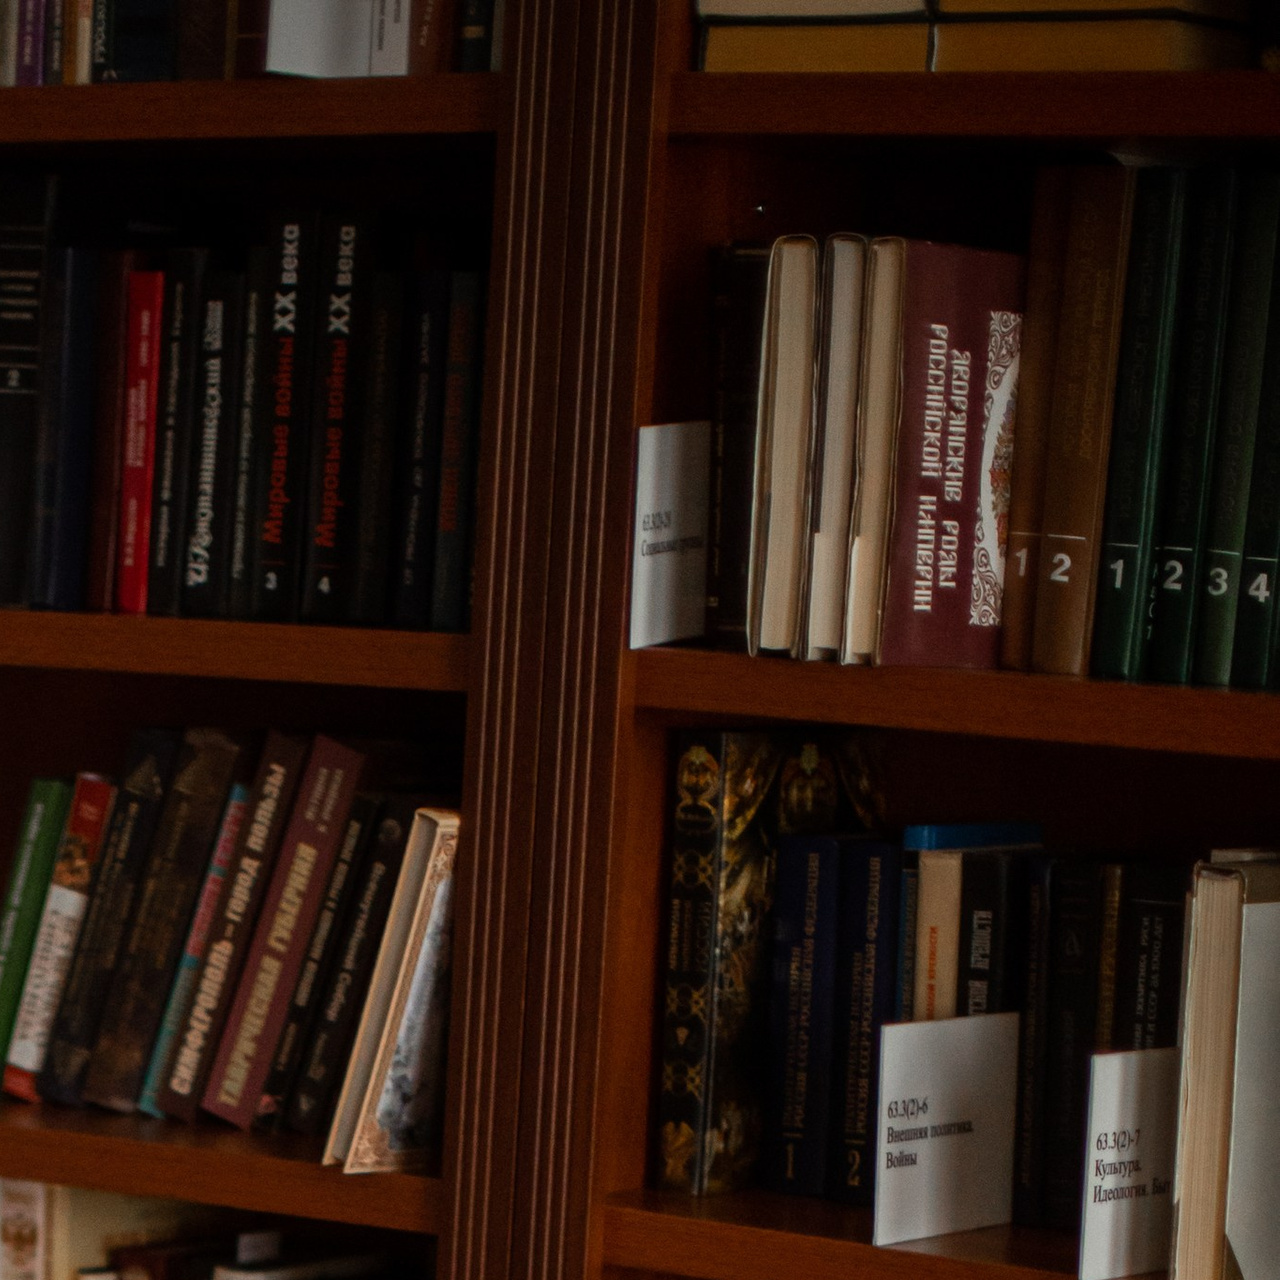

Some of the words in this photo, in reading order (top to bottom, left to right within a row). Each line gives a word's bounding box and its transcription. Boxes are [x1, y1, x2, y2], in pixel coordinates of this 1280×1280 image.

[282, 222, 301, 286] века
[336, 225, 356, 288] века
[273, 336, 296, 419] войны
[328, 339, 349, 421] войны
[920, 323, 949, 479] РОССИЙСКОЙ
[263, 425, 290, 543] Мировые
[316, 429, 344, 548] Мировые
[913, 496, 937, 613] ИМПЕРИИ
[937, 520, 960, 590] РОДЫ
[1016, 549, 1028, 577] 1
[1049, 552, 1072, 583] 2
[318, 574, 331, 594] 4
[1110, 560, 1123, 589] 1
[1162, 560, 1183, 591] 2
[1207, 566, 1228, 597] 3
[1247, 572, 1271, 603] 4
[167, 936, 234, 1096] СИМФЕРОПОЛЬ
[243, 762, 287, 854] ПОЛЬЗЫ
[218, 954, 283, 1107] ТАВРИЧЕСКАЯ
[265, 841, 319, 953] ГУБЕРНИЯ
[888, 1098, 928, 1119] 63.3(2)-6
[887, 1126, 928, 1144] Внешняя
[1096, 1128, 1140, 1151] 63.3(2)-7
[784, 1143, 795, 1180] 1
[846, 1149, 862, 1187] 2
[886, 1152, 917, 1169] Войны
[1095, 1159, 1142, 1180] Культура.
